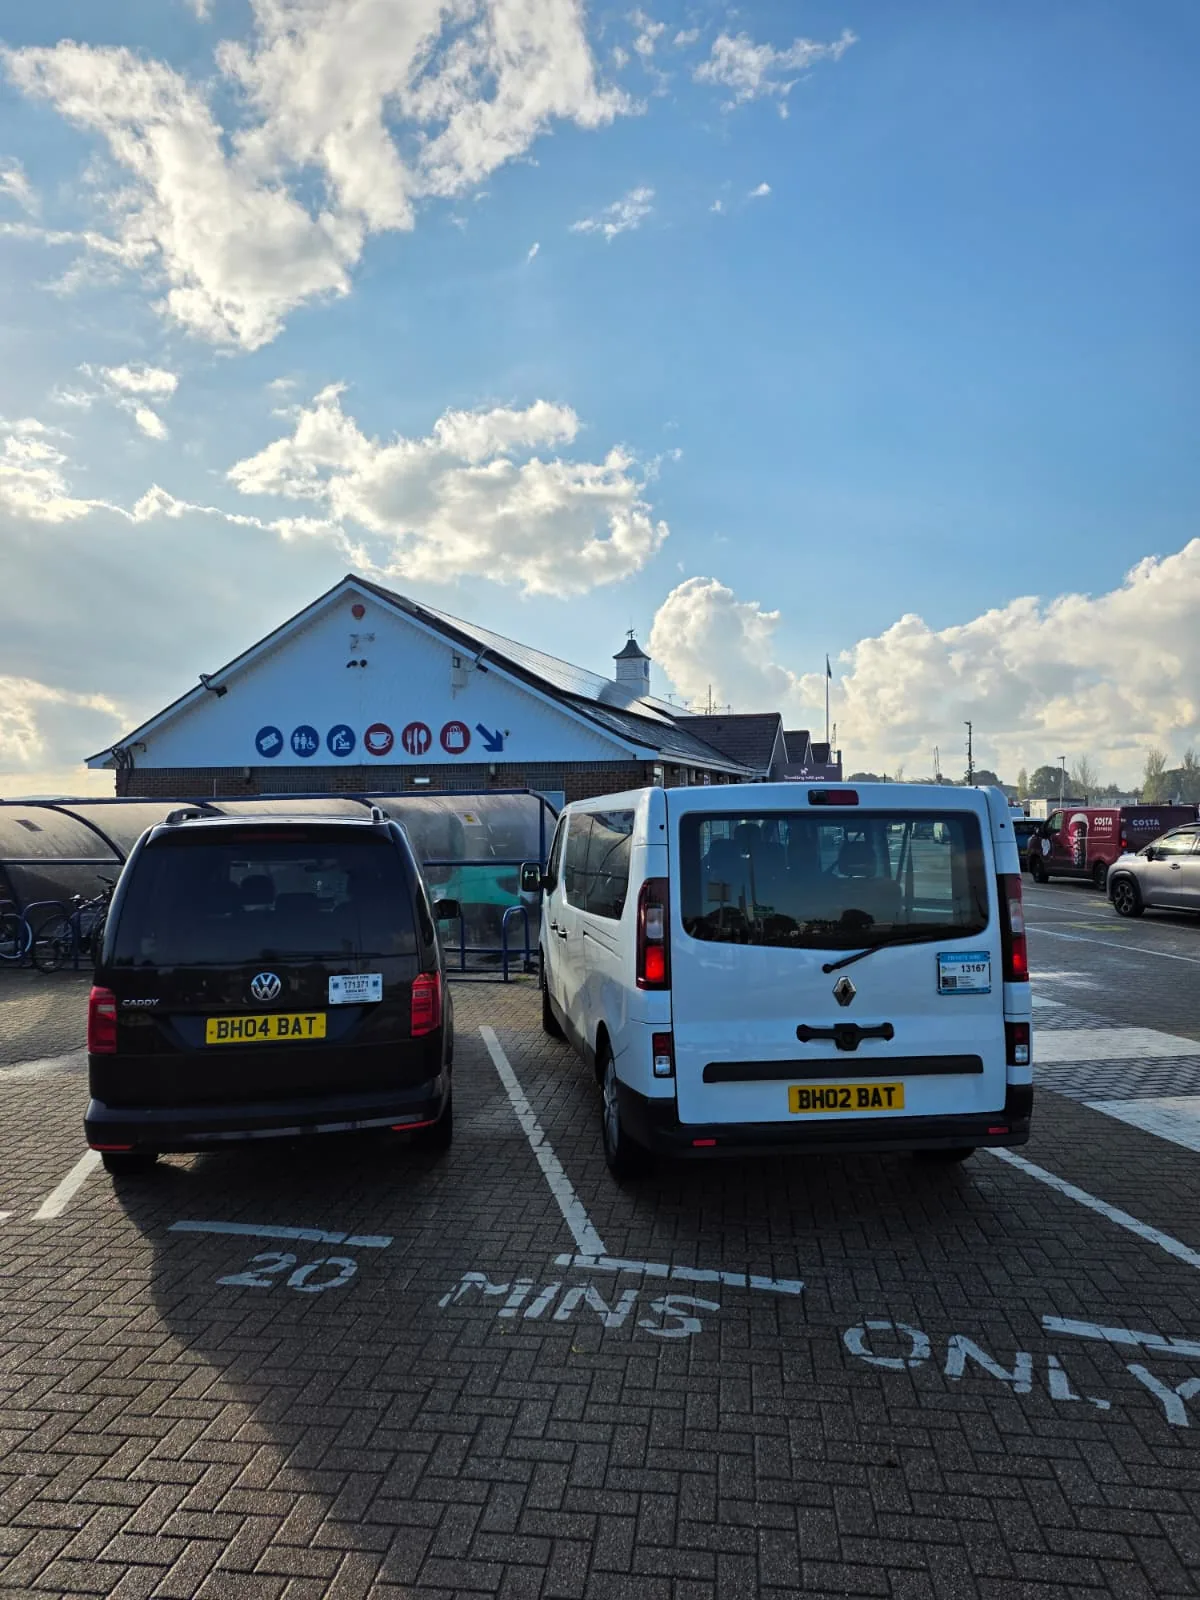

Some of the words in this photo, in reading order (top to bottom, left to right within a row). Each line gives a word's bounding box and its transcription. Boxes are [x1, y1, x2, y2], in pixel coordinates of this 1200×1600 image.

[1094, 817, 1113, 826] COSTA
[1132, 819, 1161, 827] COSTA
[961, 963, 986, 973] 13167
[121, 999, 160, 1007] CADDY
[216, 1018, 270, 1039] BH04
[276, 1016, 317, 1036] BAT
[798, 1088, 852, 1109] BH02
[856, 1086, 895, 1107] BAT
[215, 1251, 358, 1292] 20
[438, 1271, 721, 1338] MINS
[843, 1320, 1200, 1427] ONLY
